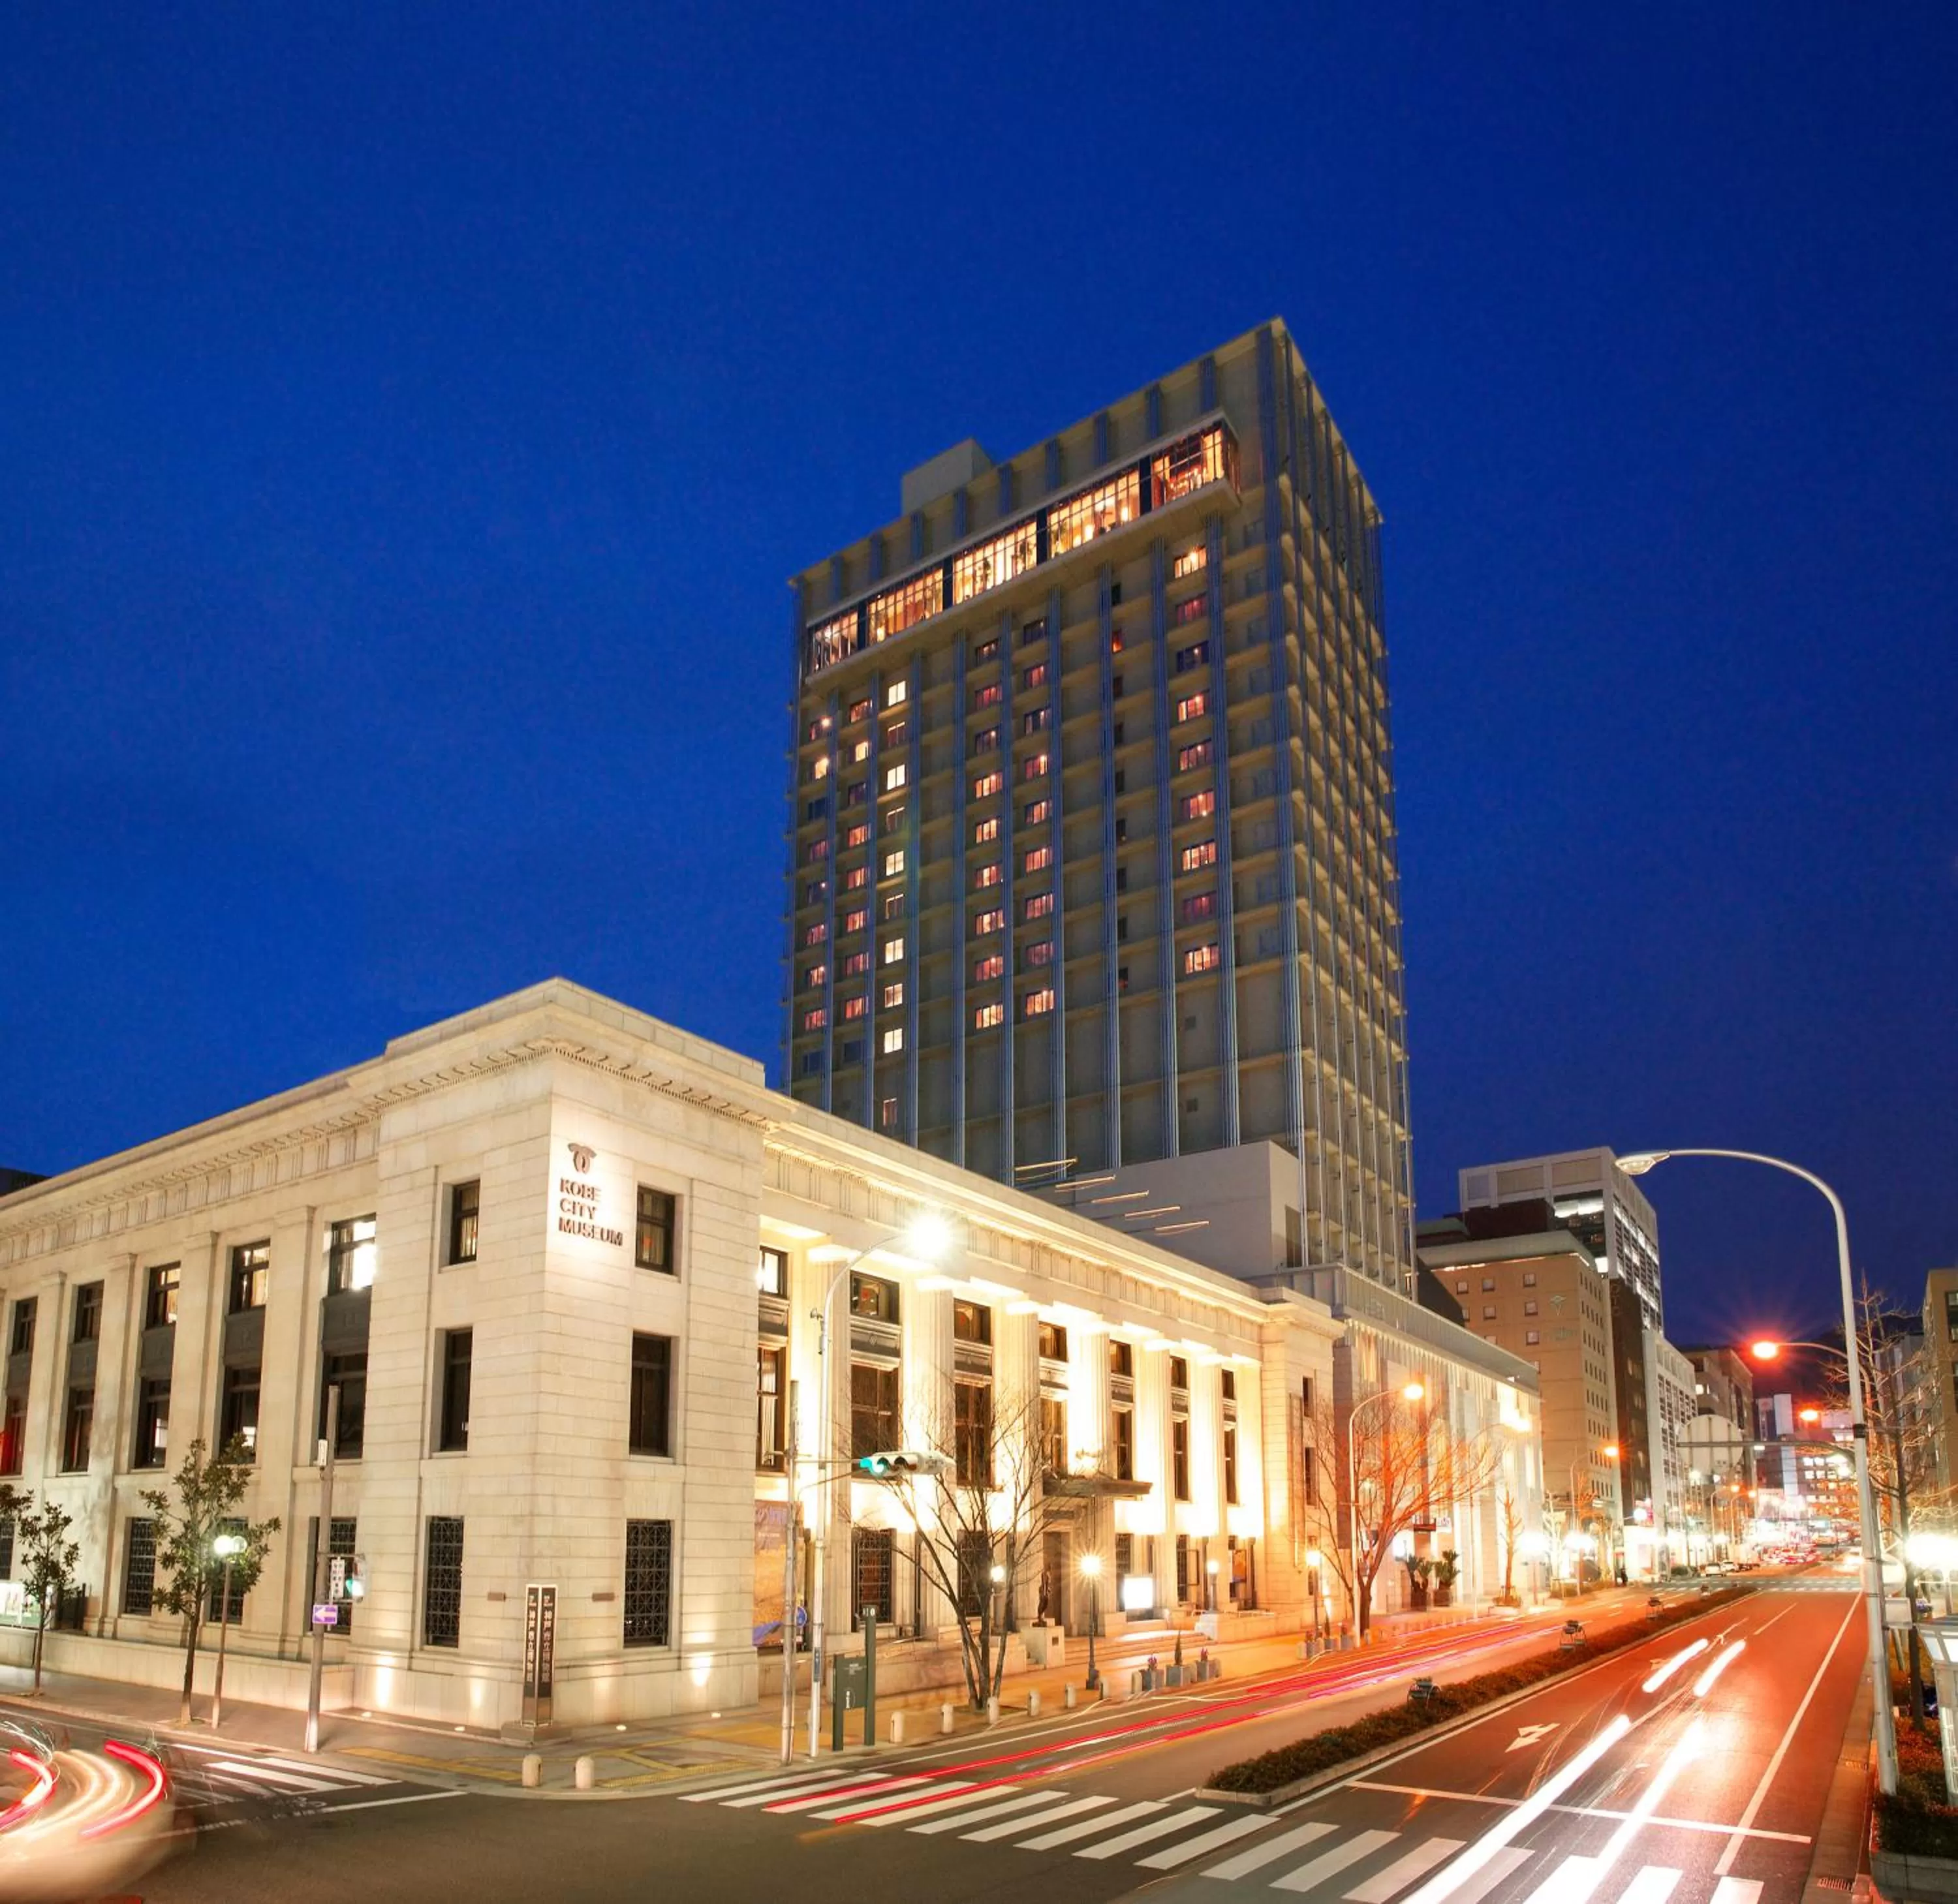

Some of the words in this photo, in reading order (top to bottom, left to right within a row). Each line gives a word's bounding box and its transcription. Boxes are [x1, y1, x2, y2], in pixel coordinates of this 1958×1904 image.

[561, 1178, 601, 1201] KOBE
[561, 1199, 596, 1219] CITY
[559, 1217, 623, 1246] MUSEUM
